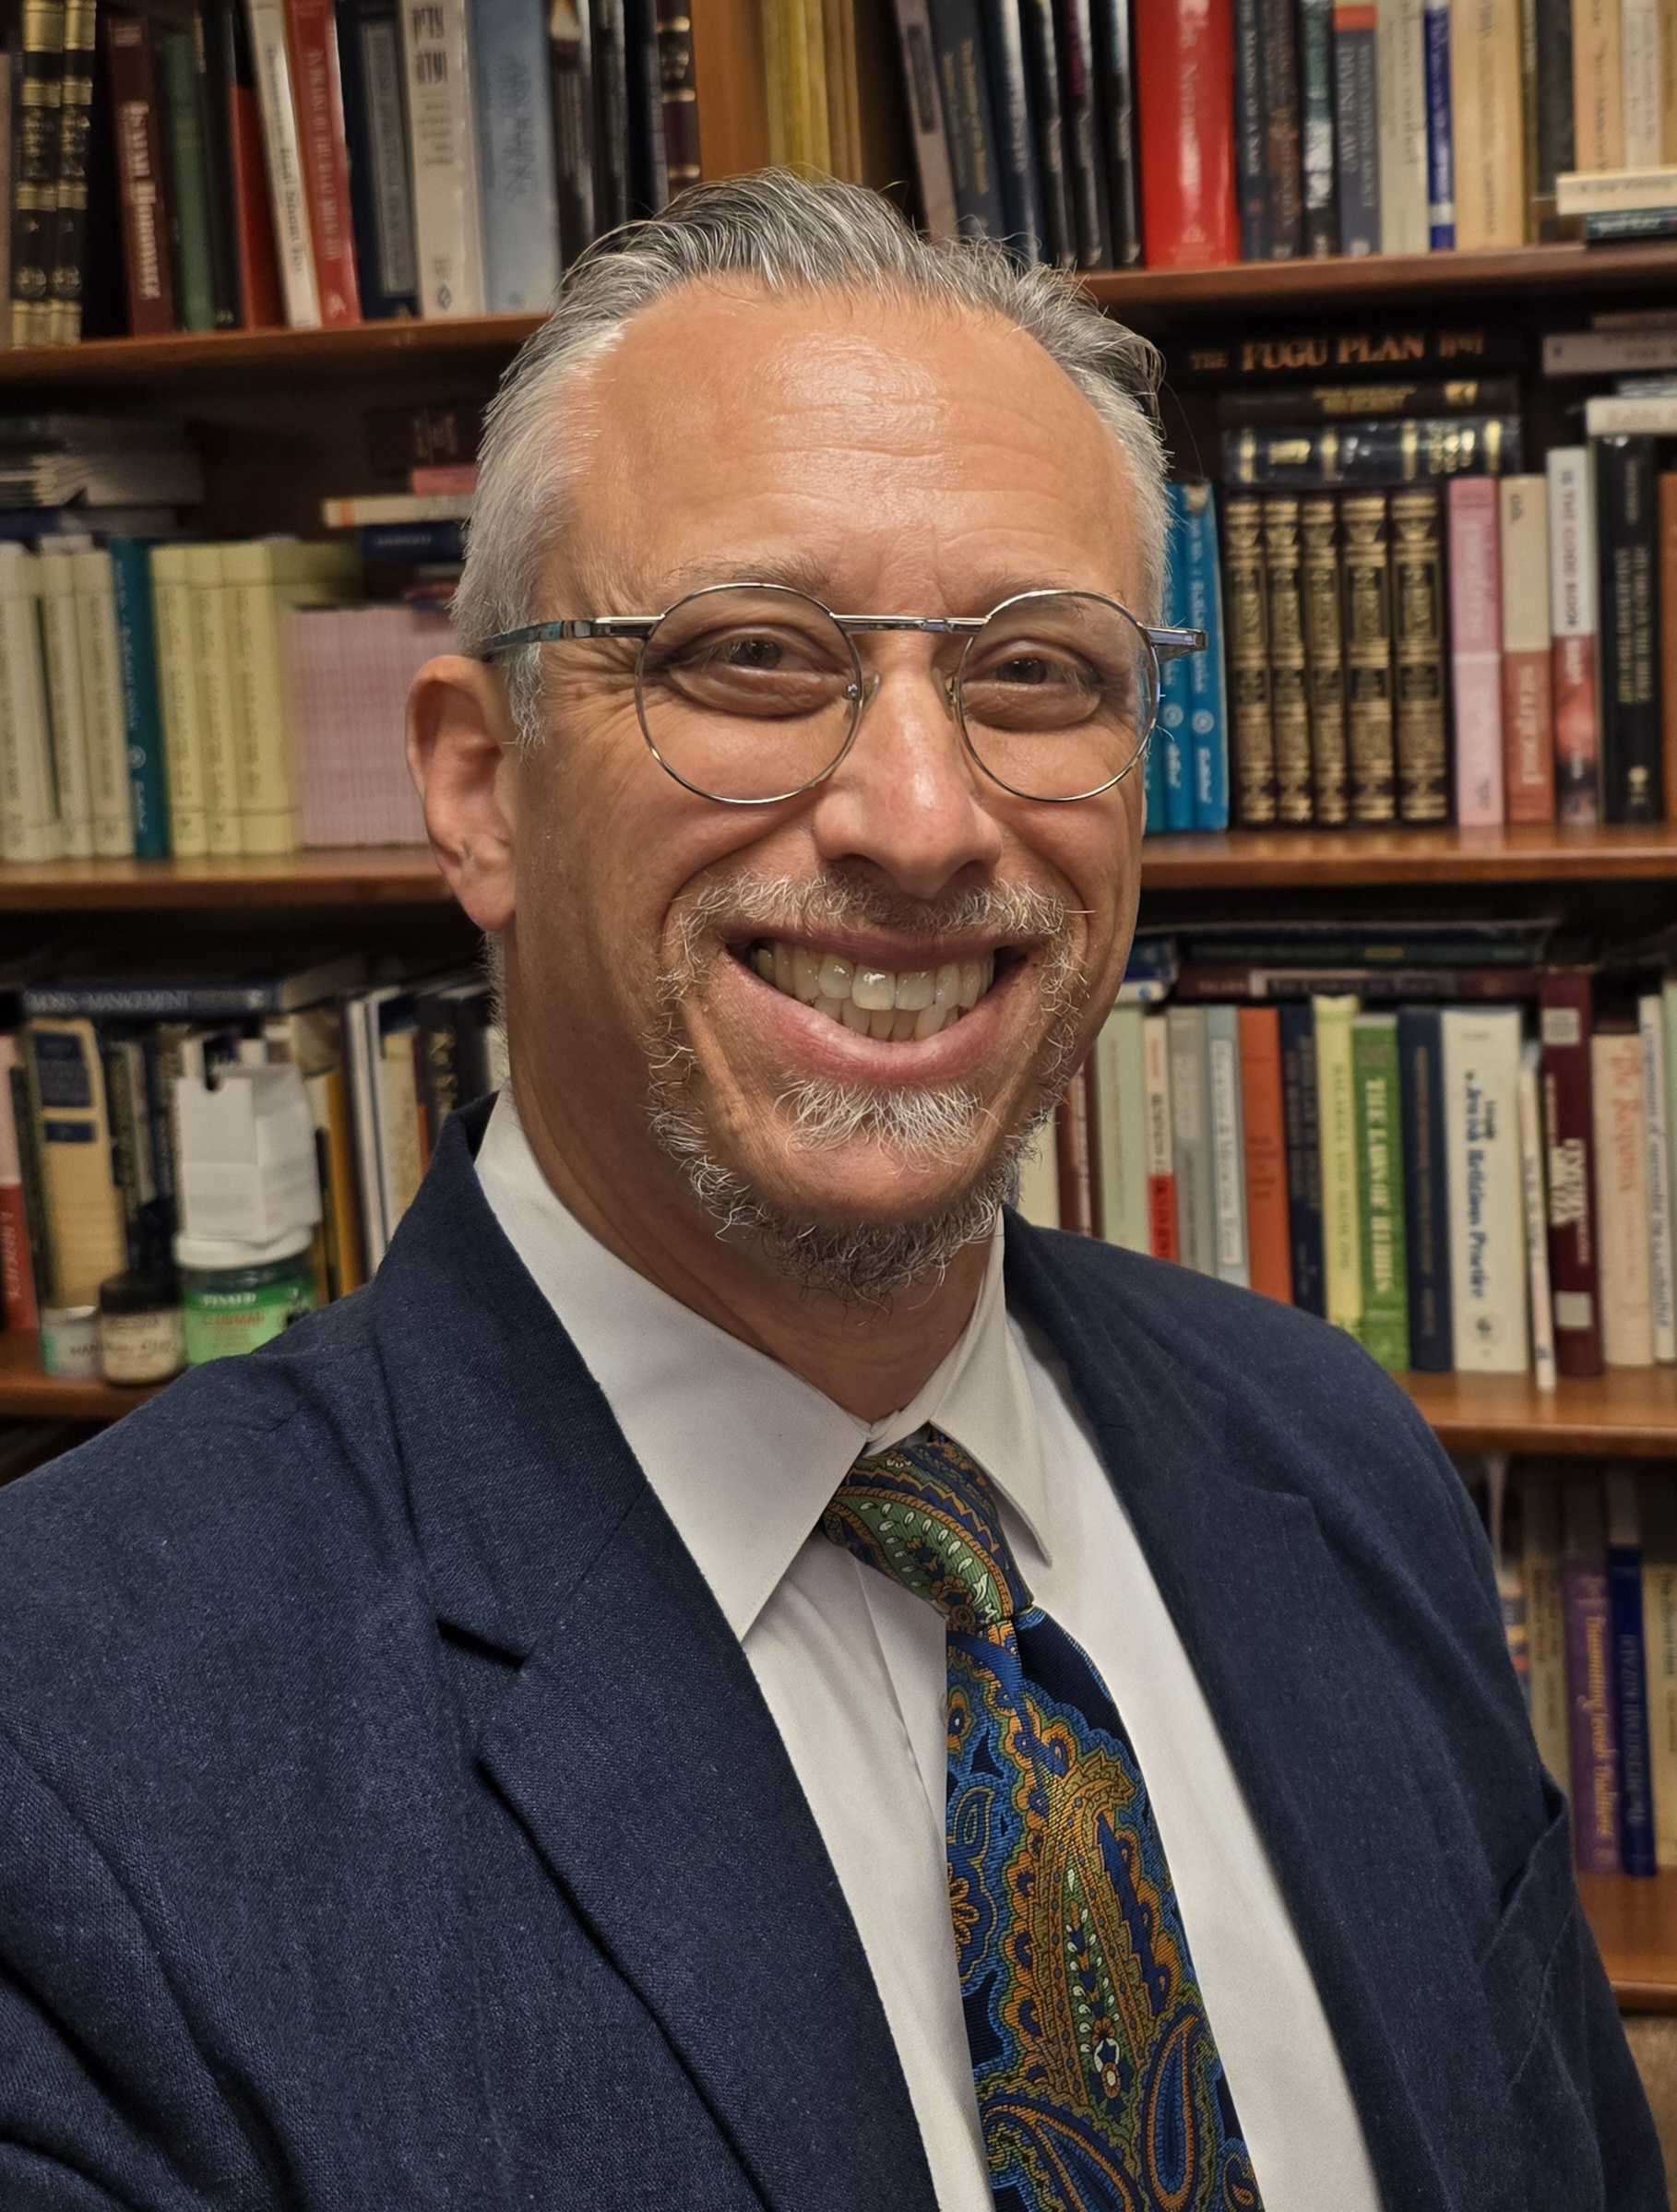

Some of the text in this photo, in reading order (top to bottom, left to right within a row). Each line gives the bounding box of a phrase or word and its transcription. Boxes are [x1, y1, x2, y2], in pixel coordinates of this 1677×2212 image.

[1243, 339, 1330, 372] FUGU
[1338, 332, 1425, 364] PLAN
[1365, 1078, 1386, 1123] THE
[1367, 1127, 1388, 1182] LAWS
[1370, 1183, 1390, 1209] OF
[1466, 1087, 1487, 1299] Jewish Religious Practice
